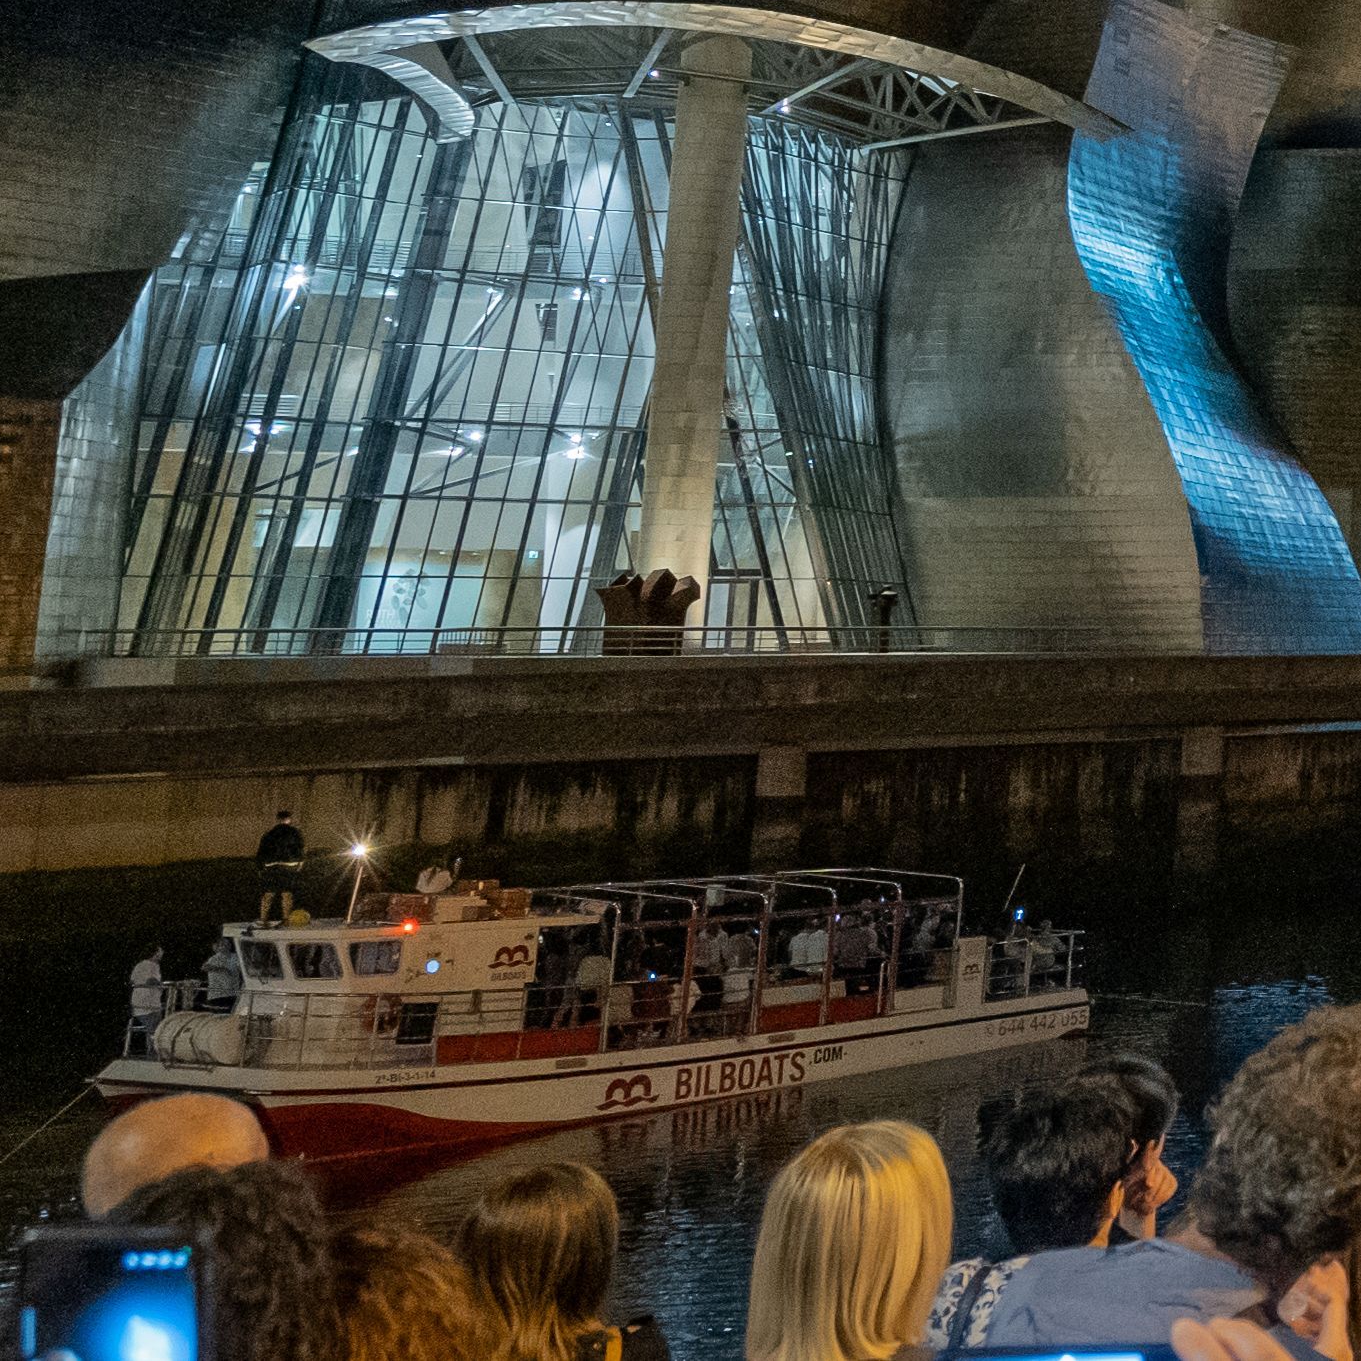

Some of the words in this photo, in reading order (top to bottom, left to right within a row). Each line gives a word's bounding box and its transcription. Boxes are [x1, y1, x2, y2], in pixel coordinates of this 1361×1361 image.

[998, 1020, 1025, 1036] 644
[1030, 1014, 1055, 1031] 442
[1061, 1009, 1087, 1026] 055
